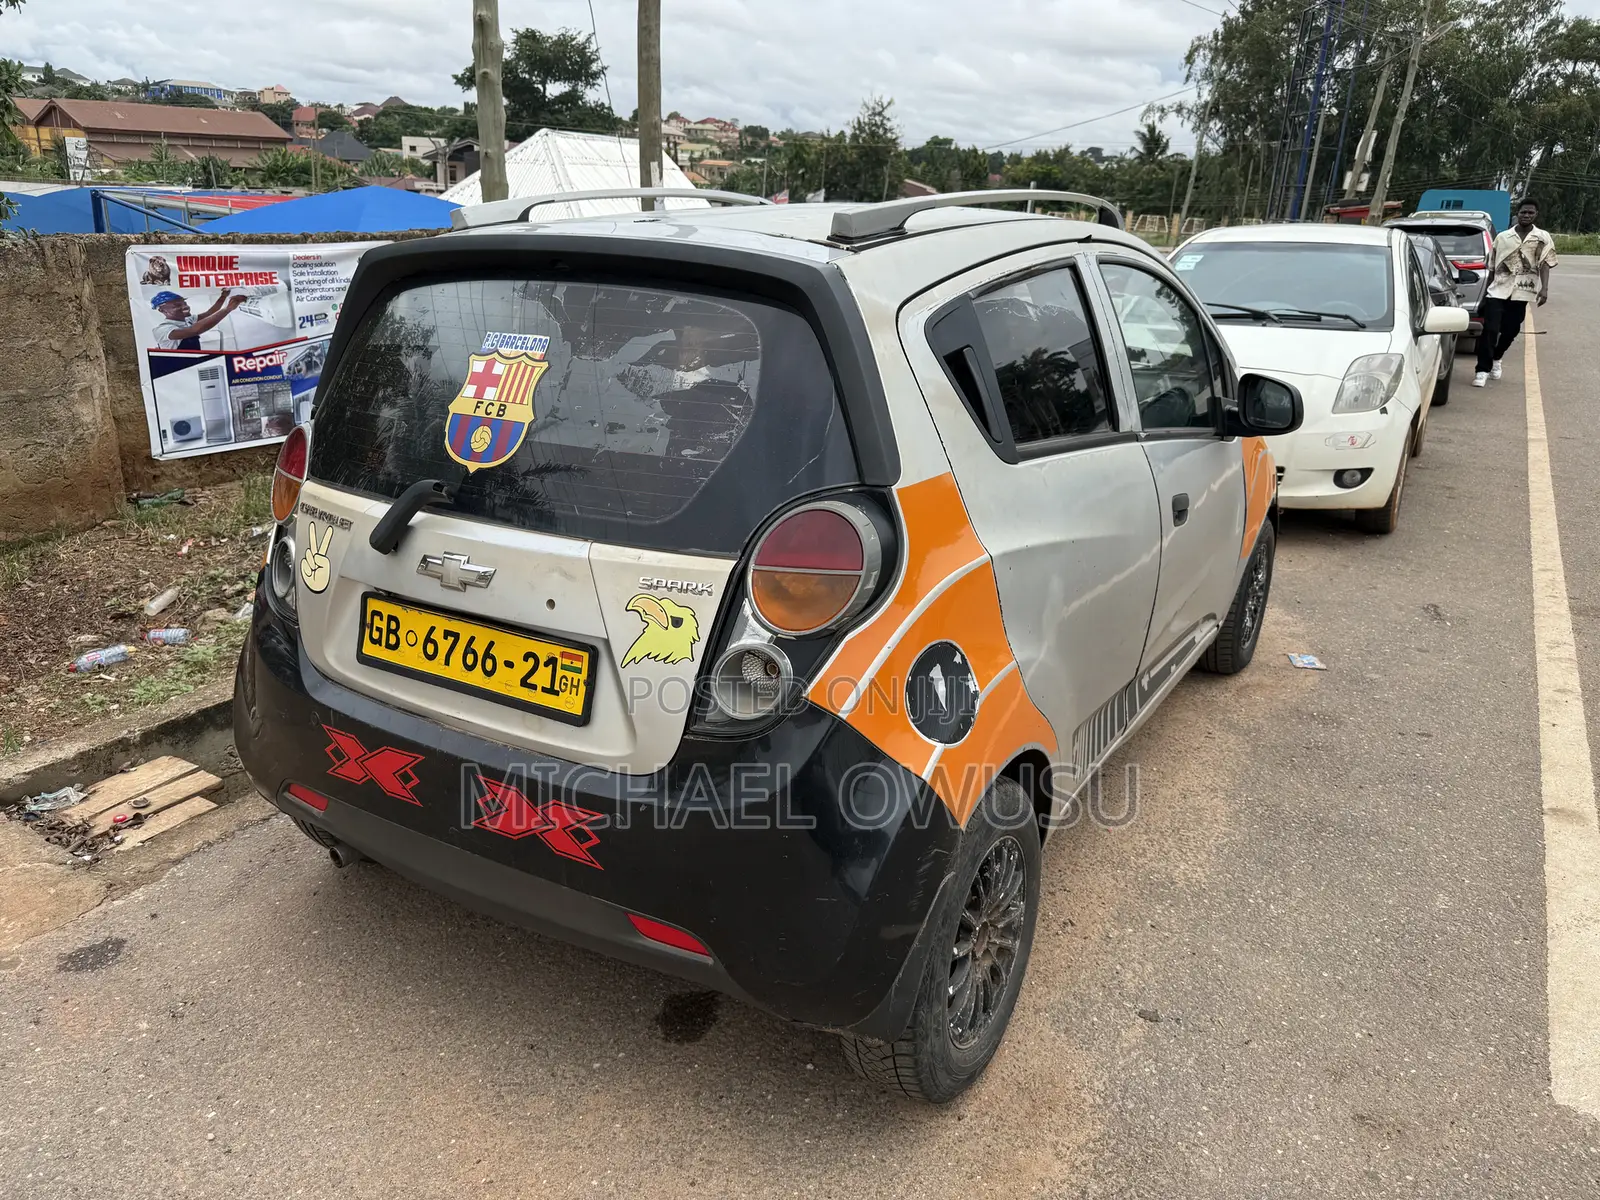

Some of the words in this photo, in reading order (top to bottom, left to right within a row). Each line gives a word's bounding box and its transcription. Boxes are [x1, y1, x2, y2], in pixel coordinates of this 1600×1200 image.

[176, 255, 239, 272] UNIQUE
[292, 261, 314, 270] Cooling
[178, 271, 279, 288] ENTERPRISE
[294, 278, 321, 287] Servicing
[294, 287, 335, 295] Refrigerators
[298, 314, 315, 330] 24
[499, 334, 549, 353] BARCELONA
[233, 351, 287, 373] Repair
[473, 401, 507, 418] FCB
[639, 576, 714, 596] SPARK
[368, 609, 401, 651] GB
[558, 674, 581, 697] GH
